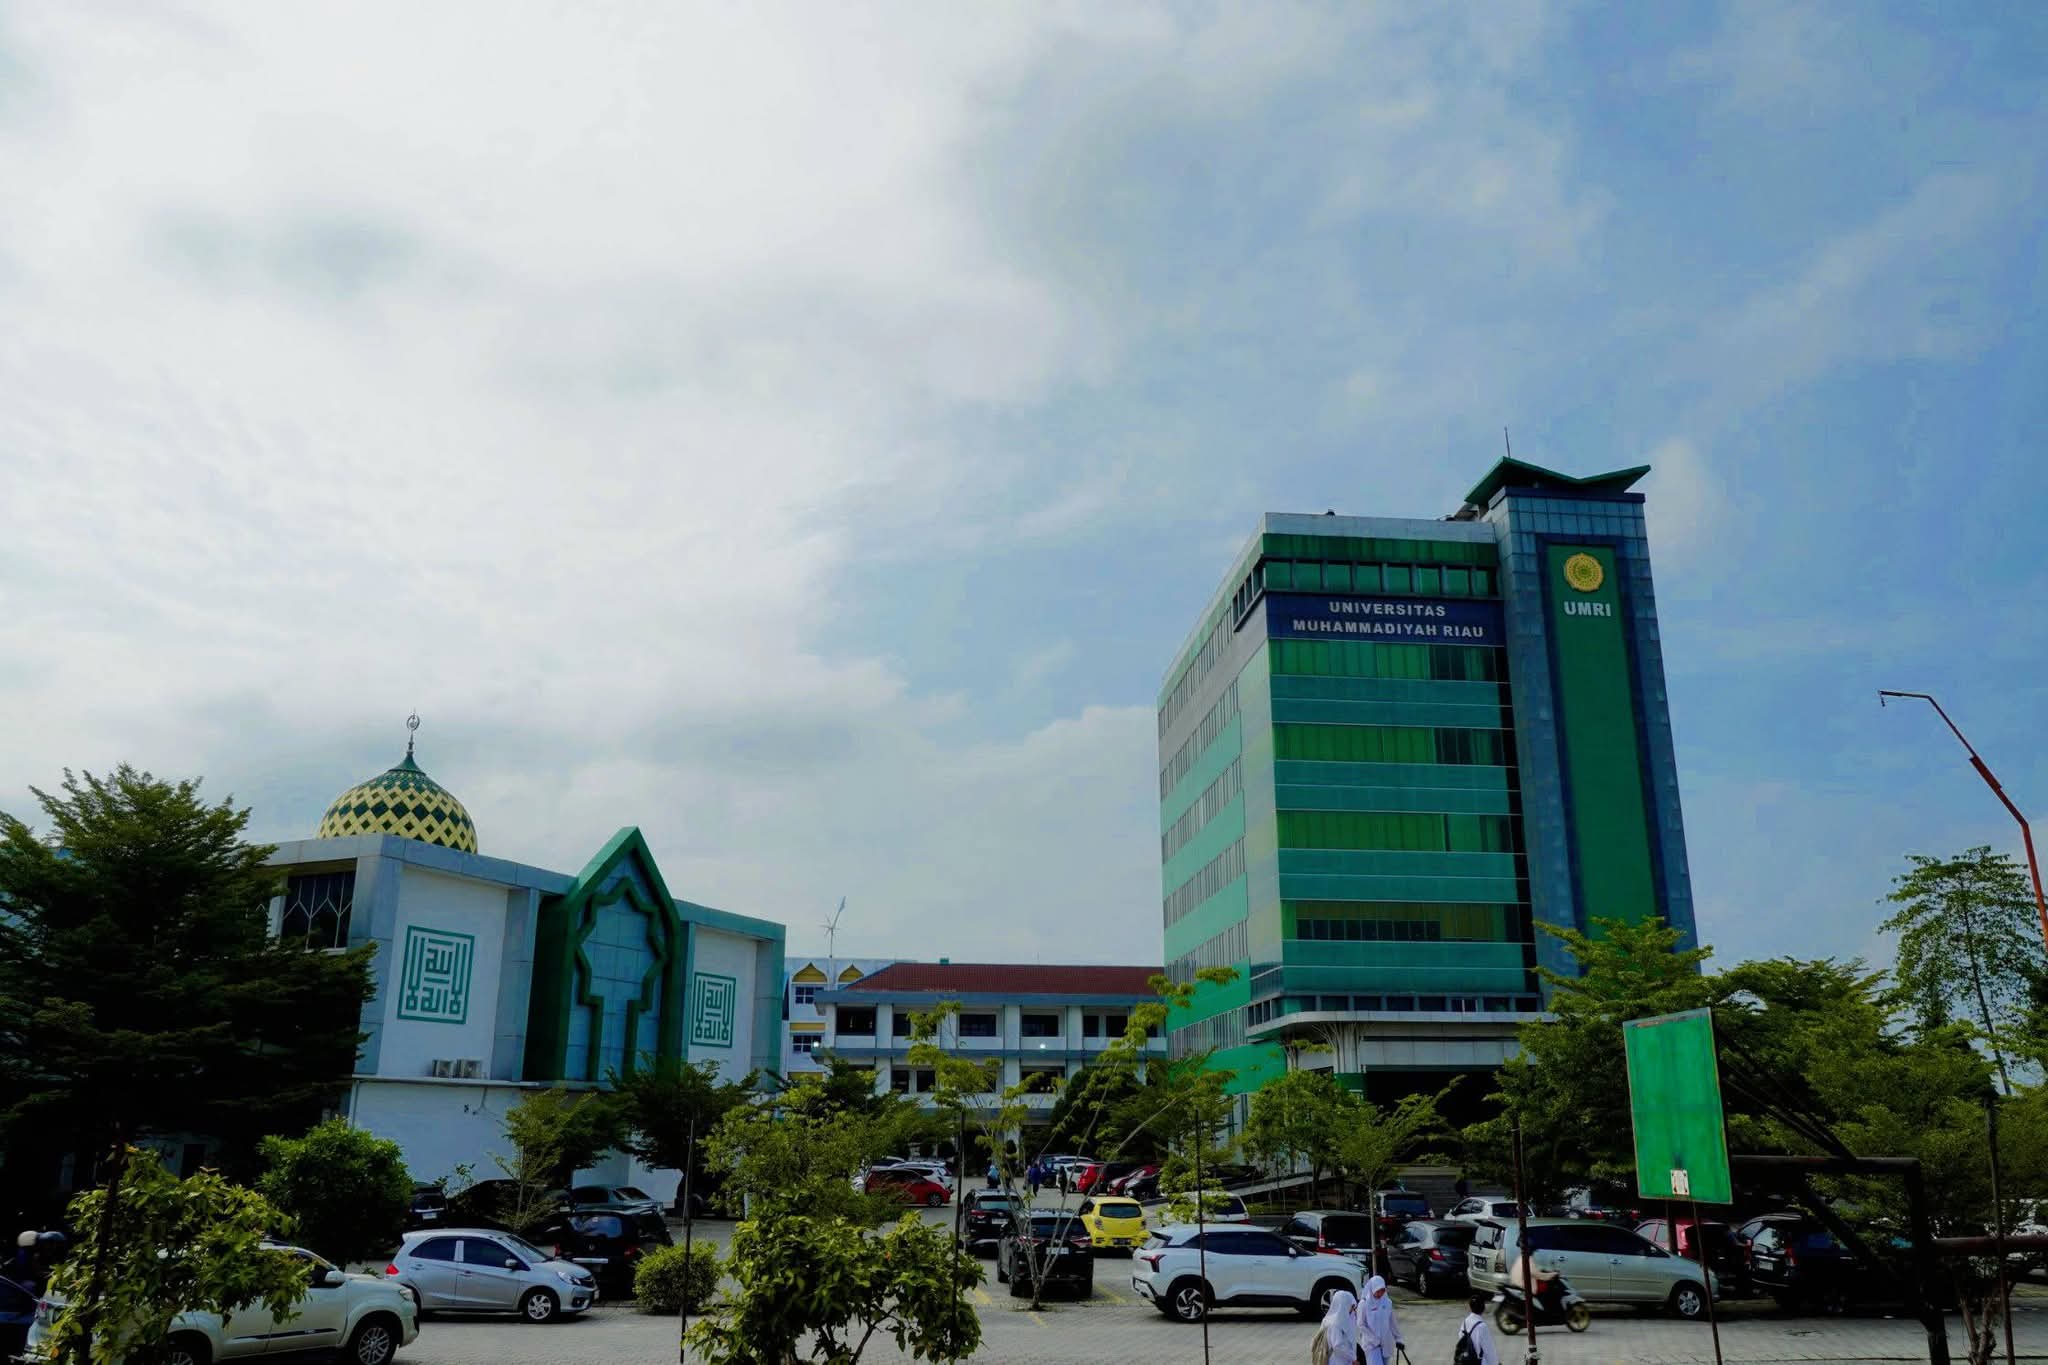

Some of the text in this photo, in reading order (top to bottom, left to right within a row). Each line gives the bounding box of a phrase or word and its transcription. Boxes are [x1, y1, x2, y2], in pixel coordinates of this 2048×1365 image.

[1329, 601, 1446, 617] UNIVERSITAS
[1563, 601, 1612, 617] UMRI
[1293, 619, 1484, 638] MUHAMMADIYAH RIAU
